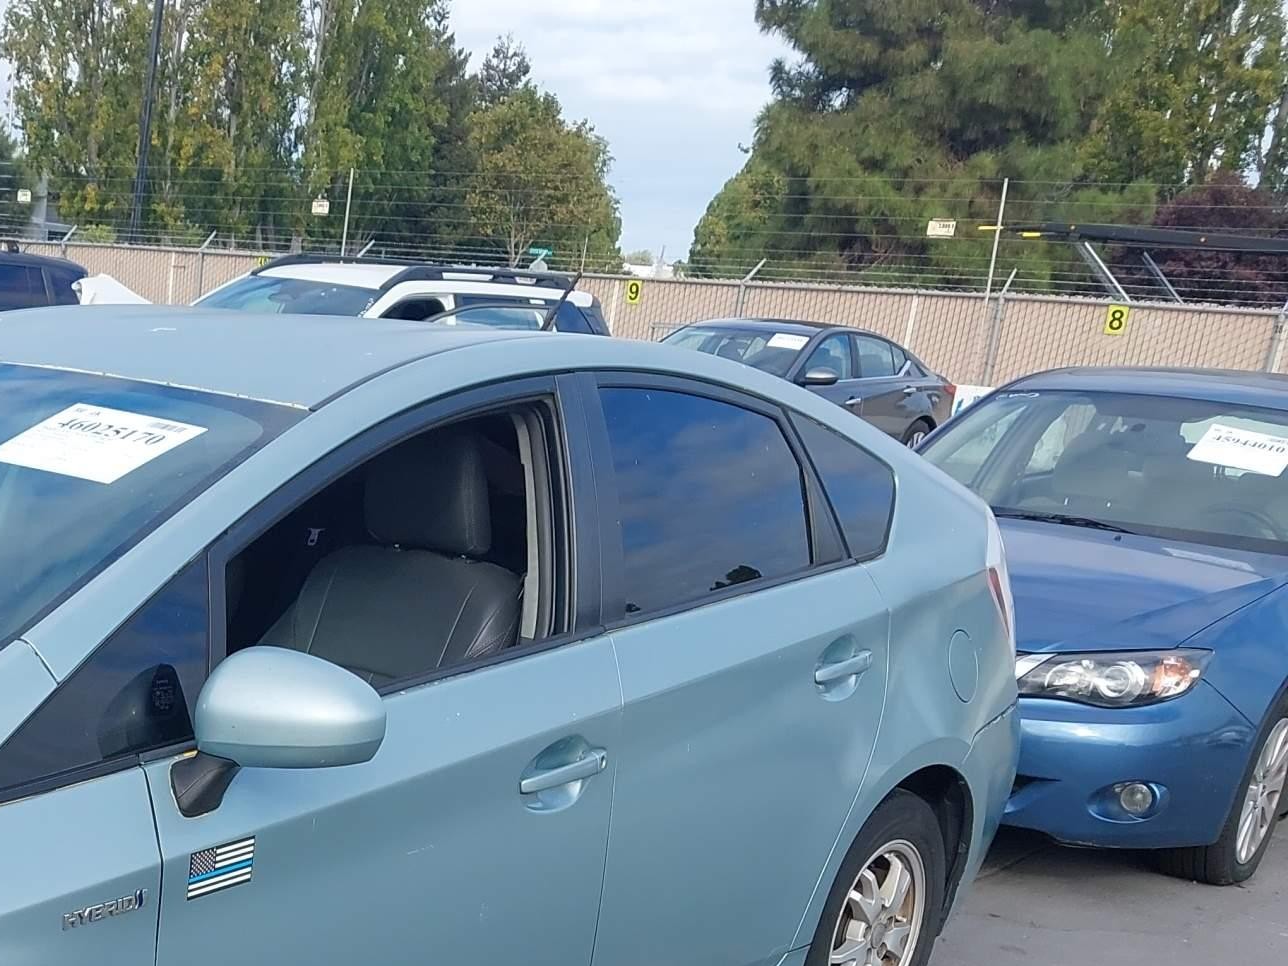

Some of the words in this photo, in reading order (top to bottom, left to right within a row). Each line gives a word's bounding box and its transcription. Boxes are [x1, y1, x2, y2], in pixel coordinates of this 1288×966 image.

[629, 282, 640, 301] 9
[1109, 309, 1124, 331] 8
[57, 418, 167, 446] 46025170
[62, 893, 137, 930] HYBRID
